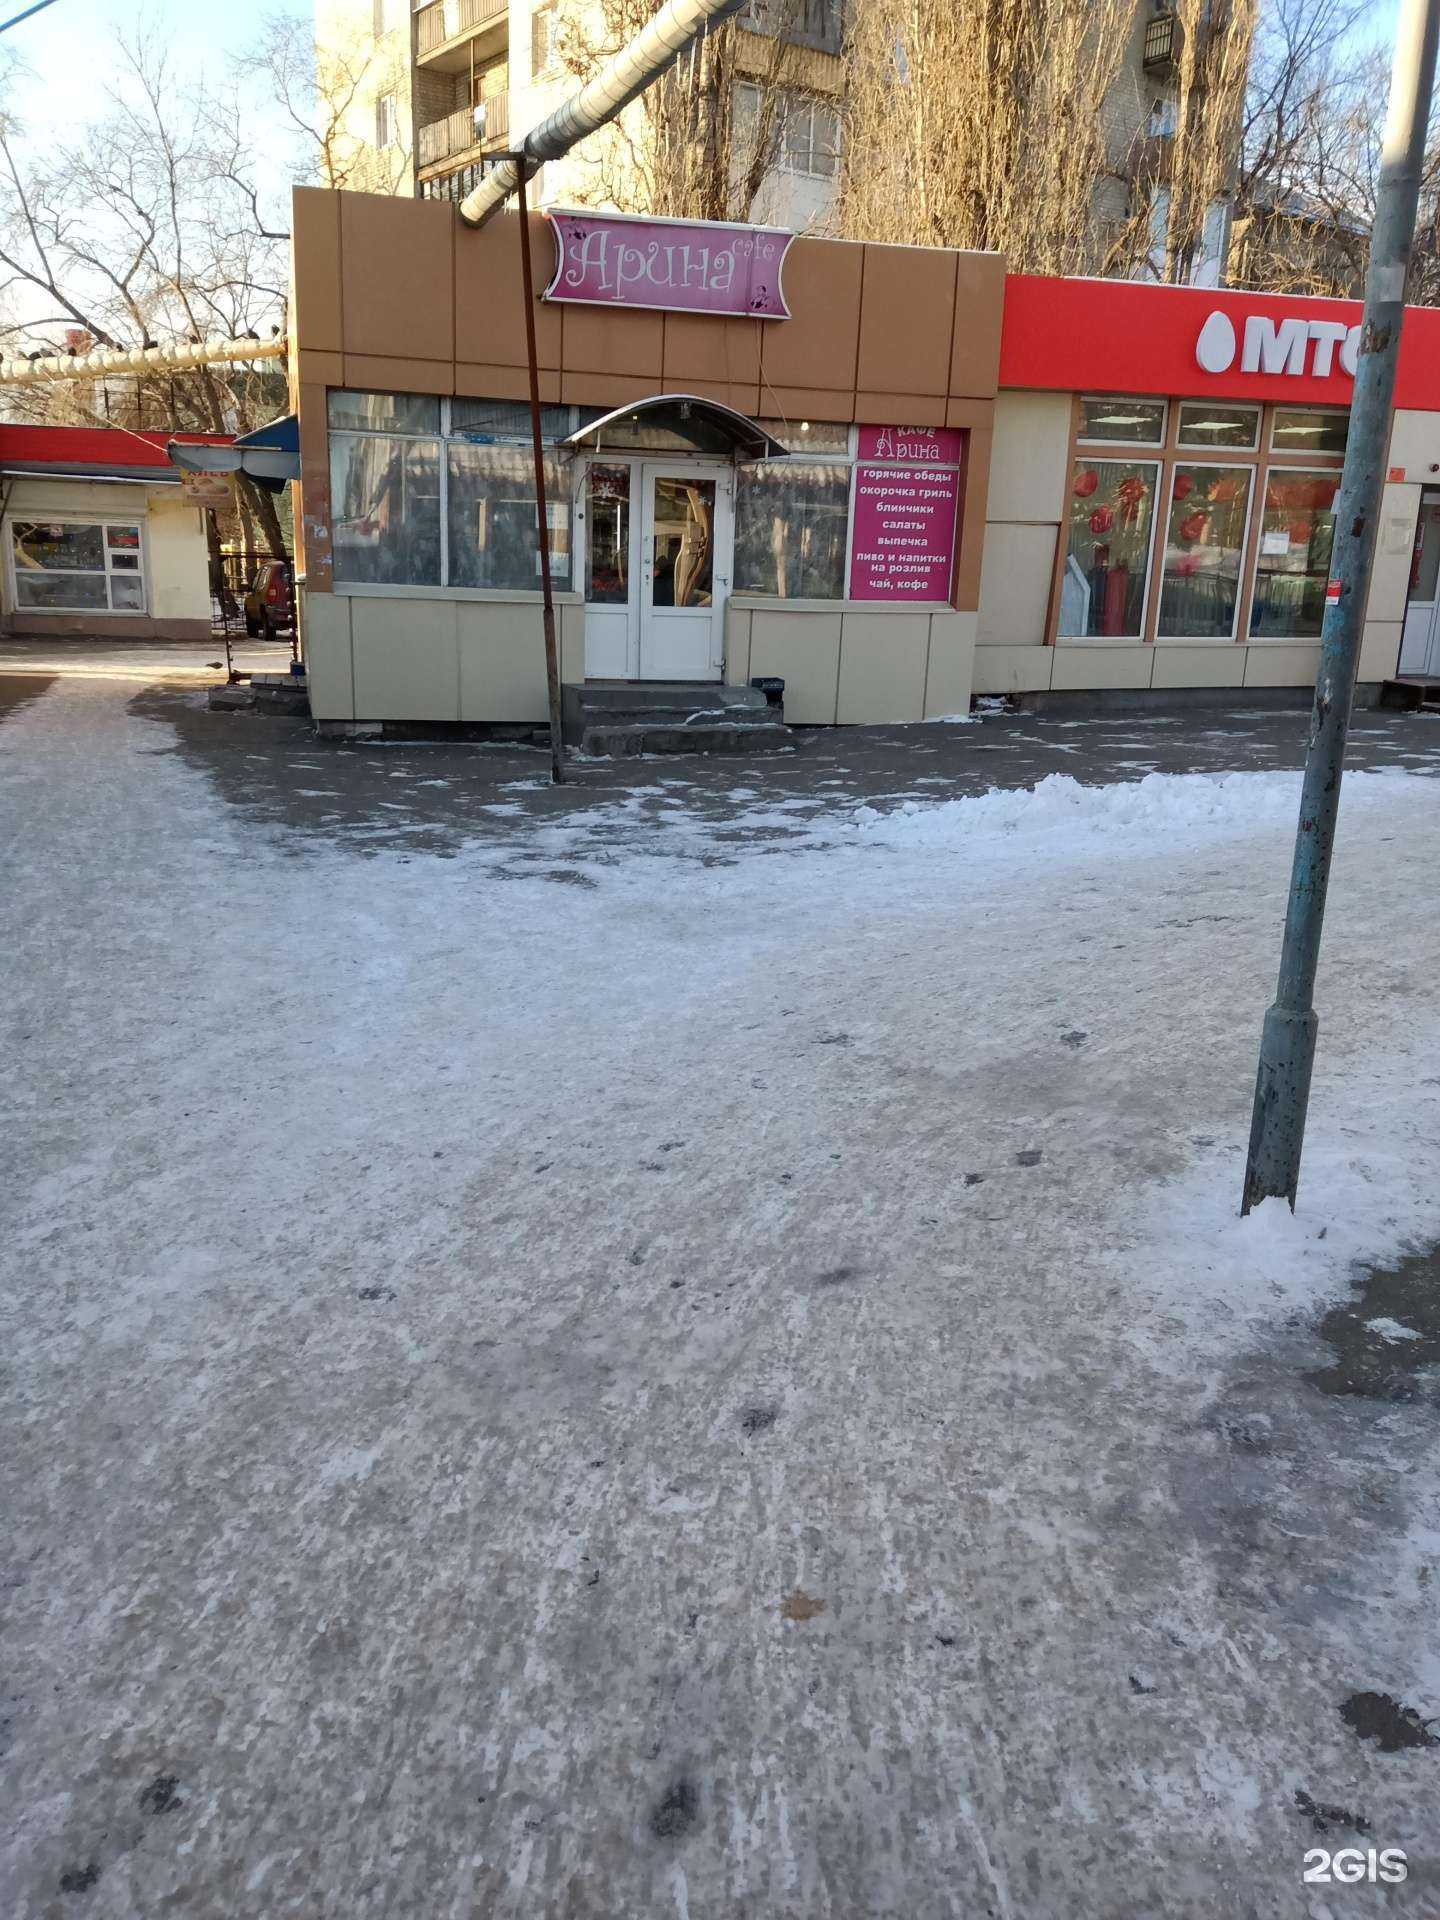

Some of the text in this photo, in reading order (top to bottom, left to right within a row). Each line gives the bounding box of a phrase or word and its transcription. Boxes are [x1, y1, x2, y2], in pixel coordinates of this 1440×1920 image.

[565, 230, 735, 299] Арина
[874, 428, 940, 461] Арина
[863, 470, 952, 483] горячие обеды
[860, 486, 952, 499] окорочка гриль
[876, 501, 934, 514] блинчики
[882, 520, 926, 530] салаты
[877, 537, 928, 546] выпечка
[856, 552, 946, 563] пиво и напитки
[871, 563, 931, 574] на розлив
[869, 579, 928, 591] чай, кофе
